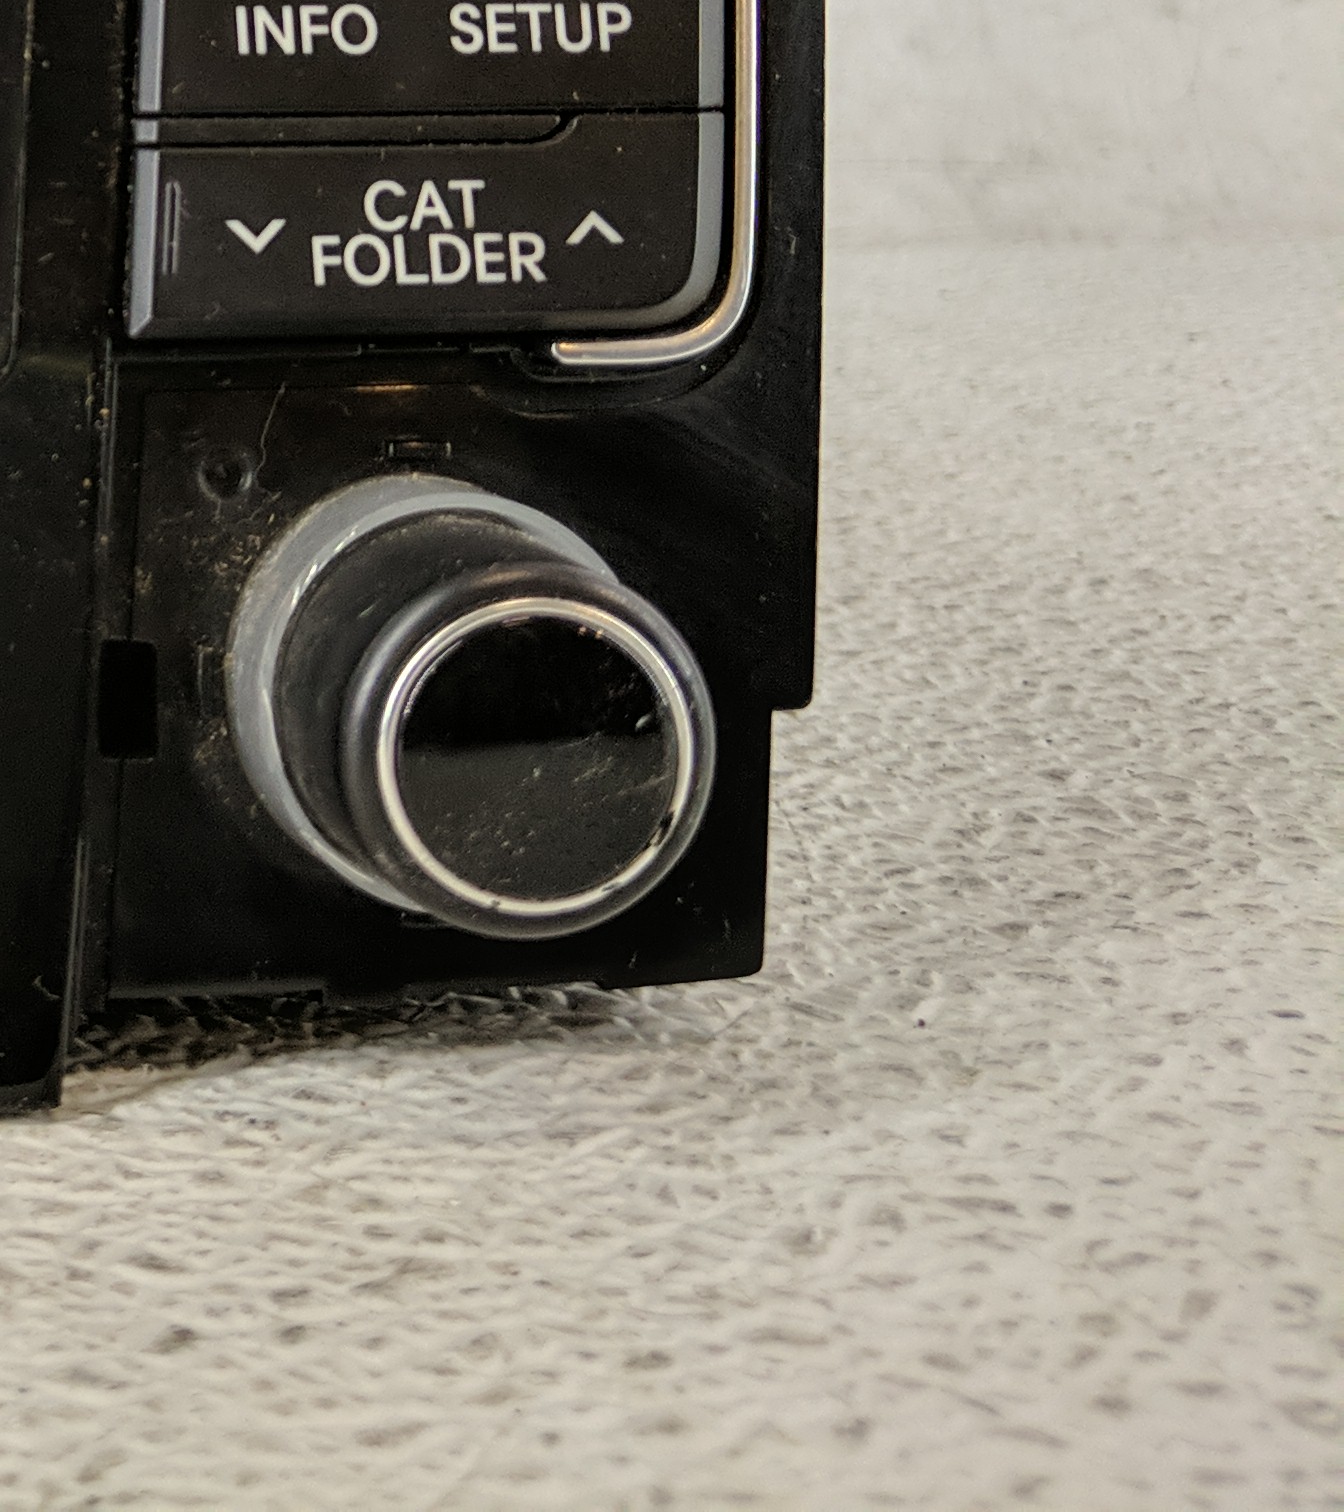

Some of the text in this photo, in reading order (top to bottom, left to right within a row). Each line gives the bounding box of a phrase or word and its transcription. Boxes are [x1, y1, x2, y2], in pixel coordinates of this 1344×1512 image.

[234, 1, 632, 55] INFO SETUP
[362, 178, 485, 231] CAT
[310, 233, 547, 287] FOLDER
